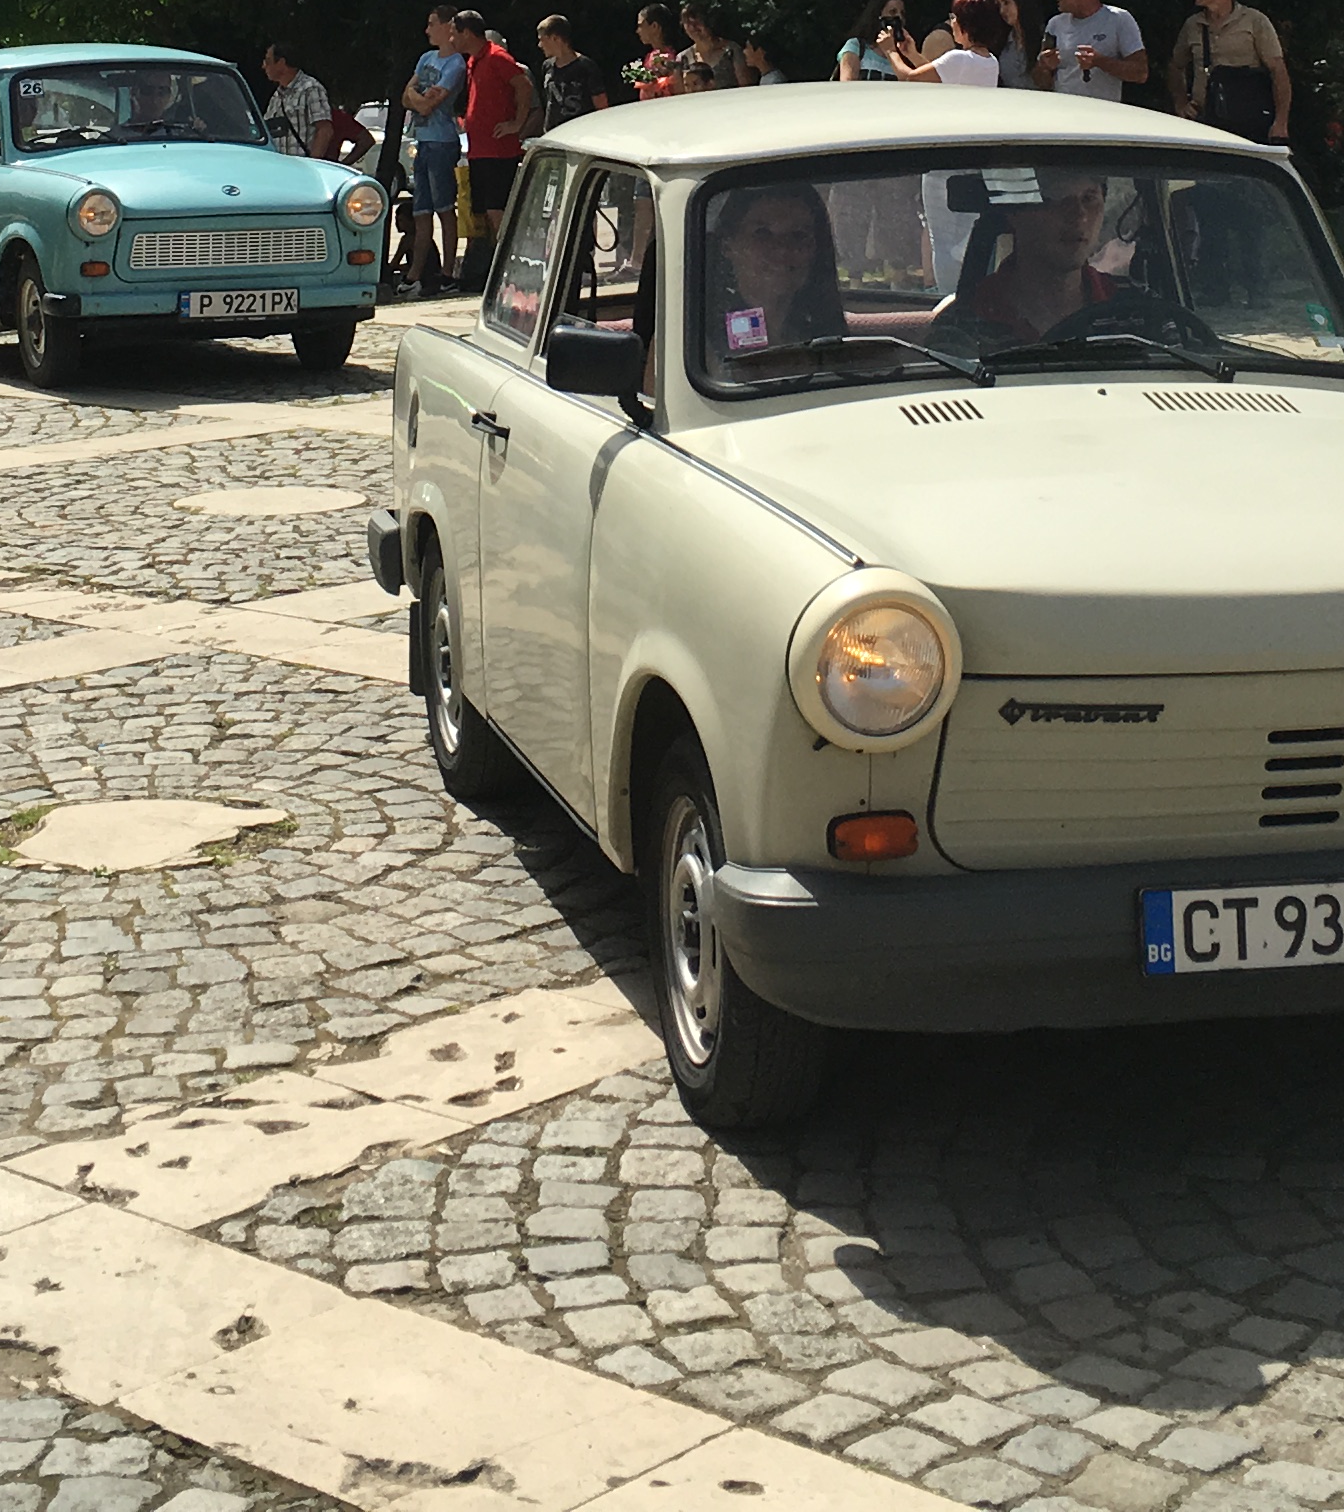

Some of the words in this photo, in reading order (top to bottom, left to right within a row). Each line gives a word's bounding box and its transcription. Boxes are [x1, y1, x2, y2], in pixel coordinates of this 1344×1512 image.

[23, 83, 42, 94] 26
[222, 292, 267, 314] 9221
[1182, 897, 1259, 963] CT
[1147, 944, 1172, 963] BG
